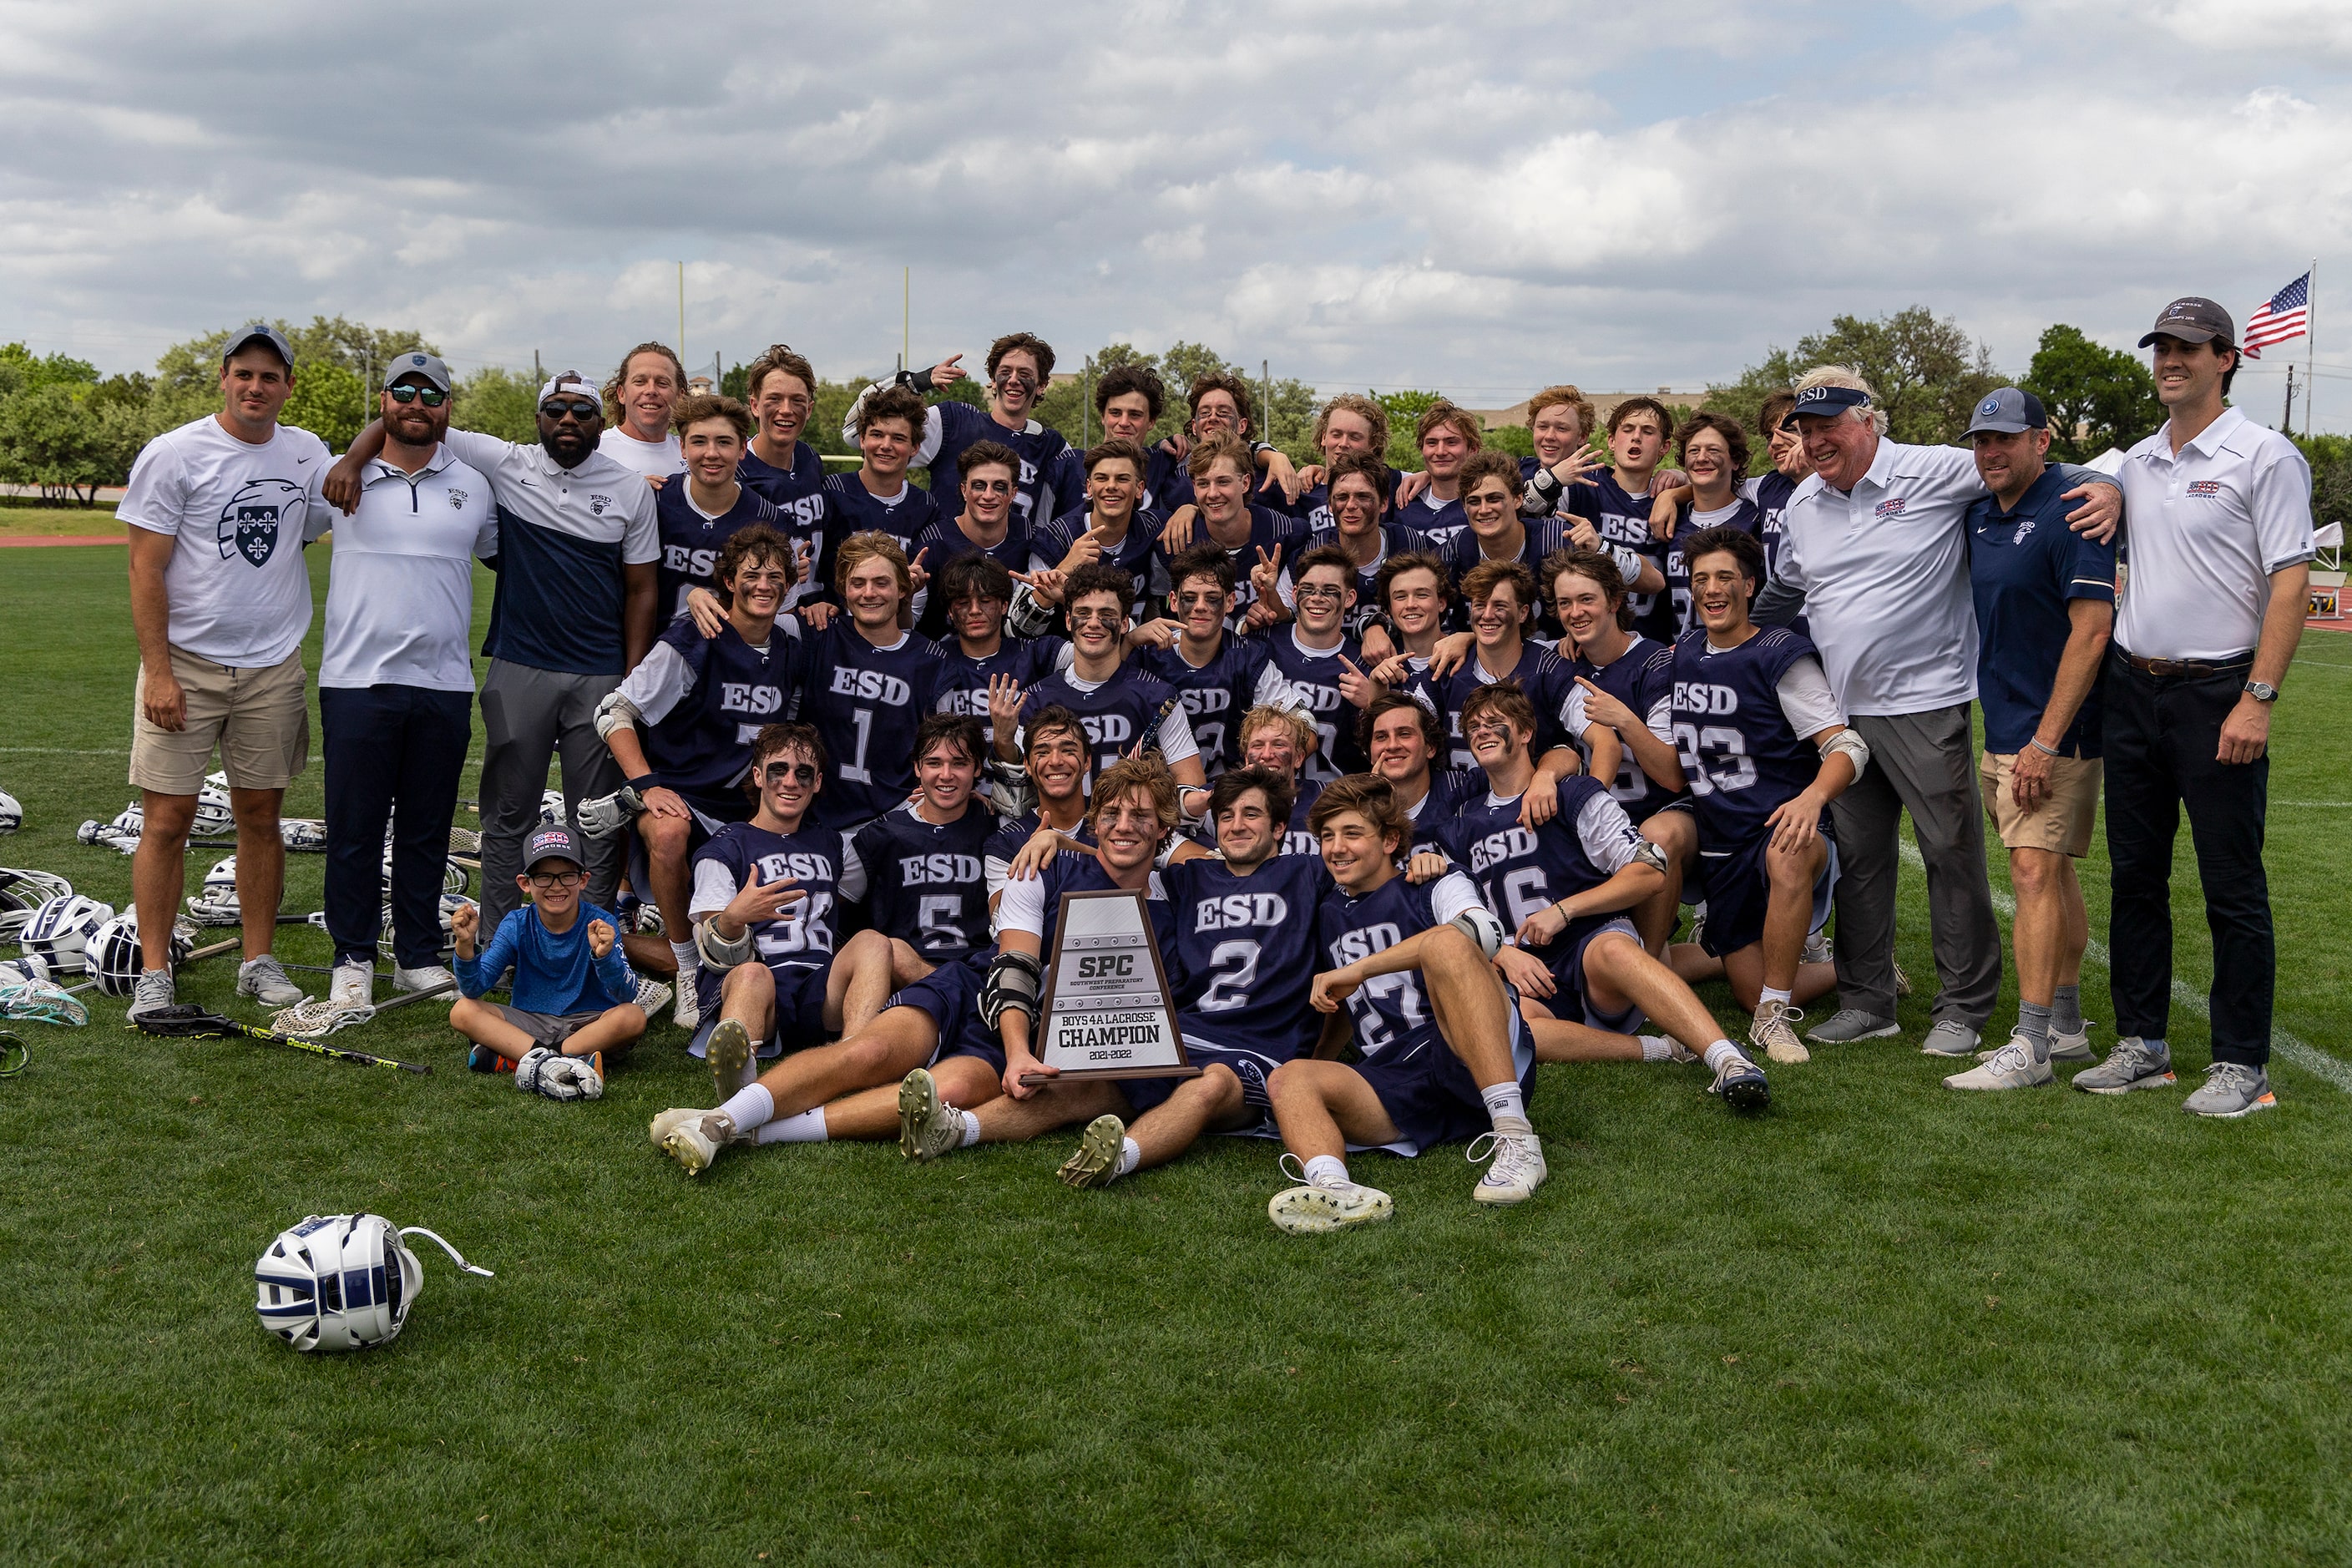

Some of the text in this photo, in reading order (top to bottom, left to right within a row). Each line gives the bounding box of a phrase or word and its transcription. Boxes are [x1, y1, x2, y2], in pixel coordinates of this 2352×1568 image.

[1798, 387, 1827, 406] ESD
[448, 488, 468, 498] ESD
[590, 494, 612, 503] ESD
[2187, 480, 2220, 494] ESD
[1600, 512, 1647, 543] ES
[663, 544, 721, 577] ES
[721, 681, 782, 715] ESD
[828, 665, 911, 707] ESD
[1292, 680, 1341, 711] SD
[1672, 681, 1738, 716] ESD
[1180, 688, 1231, 716] SD
[1080, 714, 1132, 744] SD
[838, 706, 873, 787] 1
[1672, 721, 1759, 797] 33
[532, 831, 569, 849] ESD
[533, 843, 572, 855] LACROSSE
[1469, 827, 1539, 874] ESD
[756, 852, 833, 885] ESD
[898, 852, 982, 888] ESD
[918, 893, 969, 949] 5
[1194, 892, 1288, 934] ESD
[1328, 922, 1402, 969] ESD
[1078, 954, 1134, 979] SPC
[1105, 977, 1145, 985] PREPARATORY
[1196, 938, 1262, 1013] 2
[1062, 1011, 1156, 1027] BOYS 4A LACROSSE
[1345, 969, 1427, 1058] 27
[1059, 1024, 1160, 1049] CHAMPION
[1089, 1049, 1132, 1060] 2021-2022
[1495, 1100, 1508, 1109] KITH
